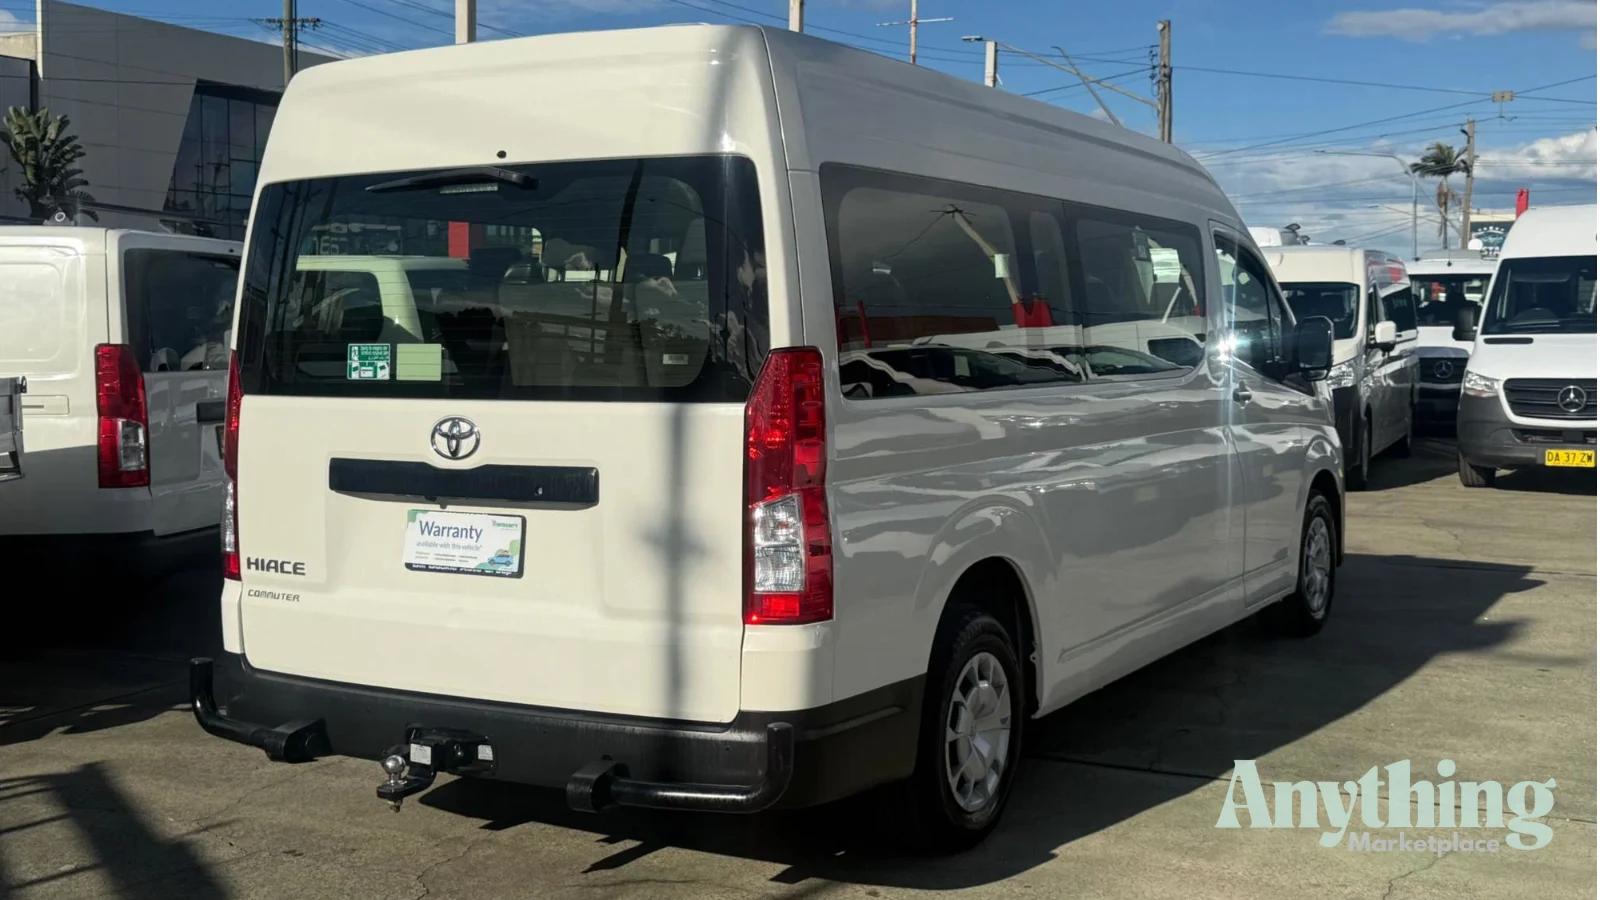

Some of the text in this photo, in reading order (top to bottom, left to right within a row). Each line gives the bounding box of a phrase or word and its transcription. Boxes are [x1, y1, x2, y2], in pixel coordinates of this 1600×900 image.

[1547, 451, 1593, 463] DA 37 ZW
[419, 519, 483, 543] Warranty
[416, 540, 438, 549] available
[451, 542, 461, 550] this
[246, 556, 306, 576] HIACE
[247, 589, 300, 602] COMMUTER
